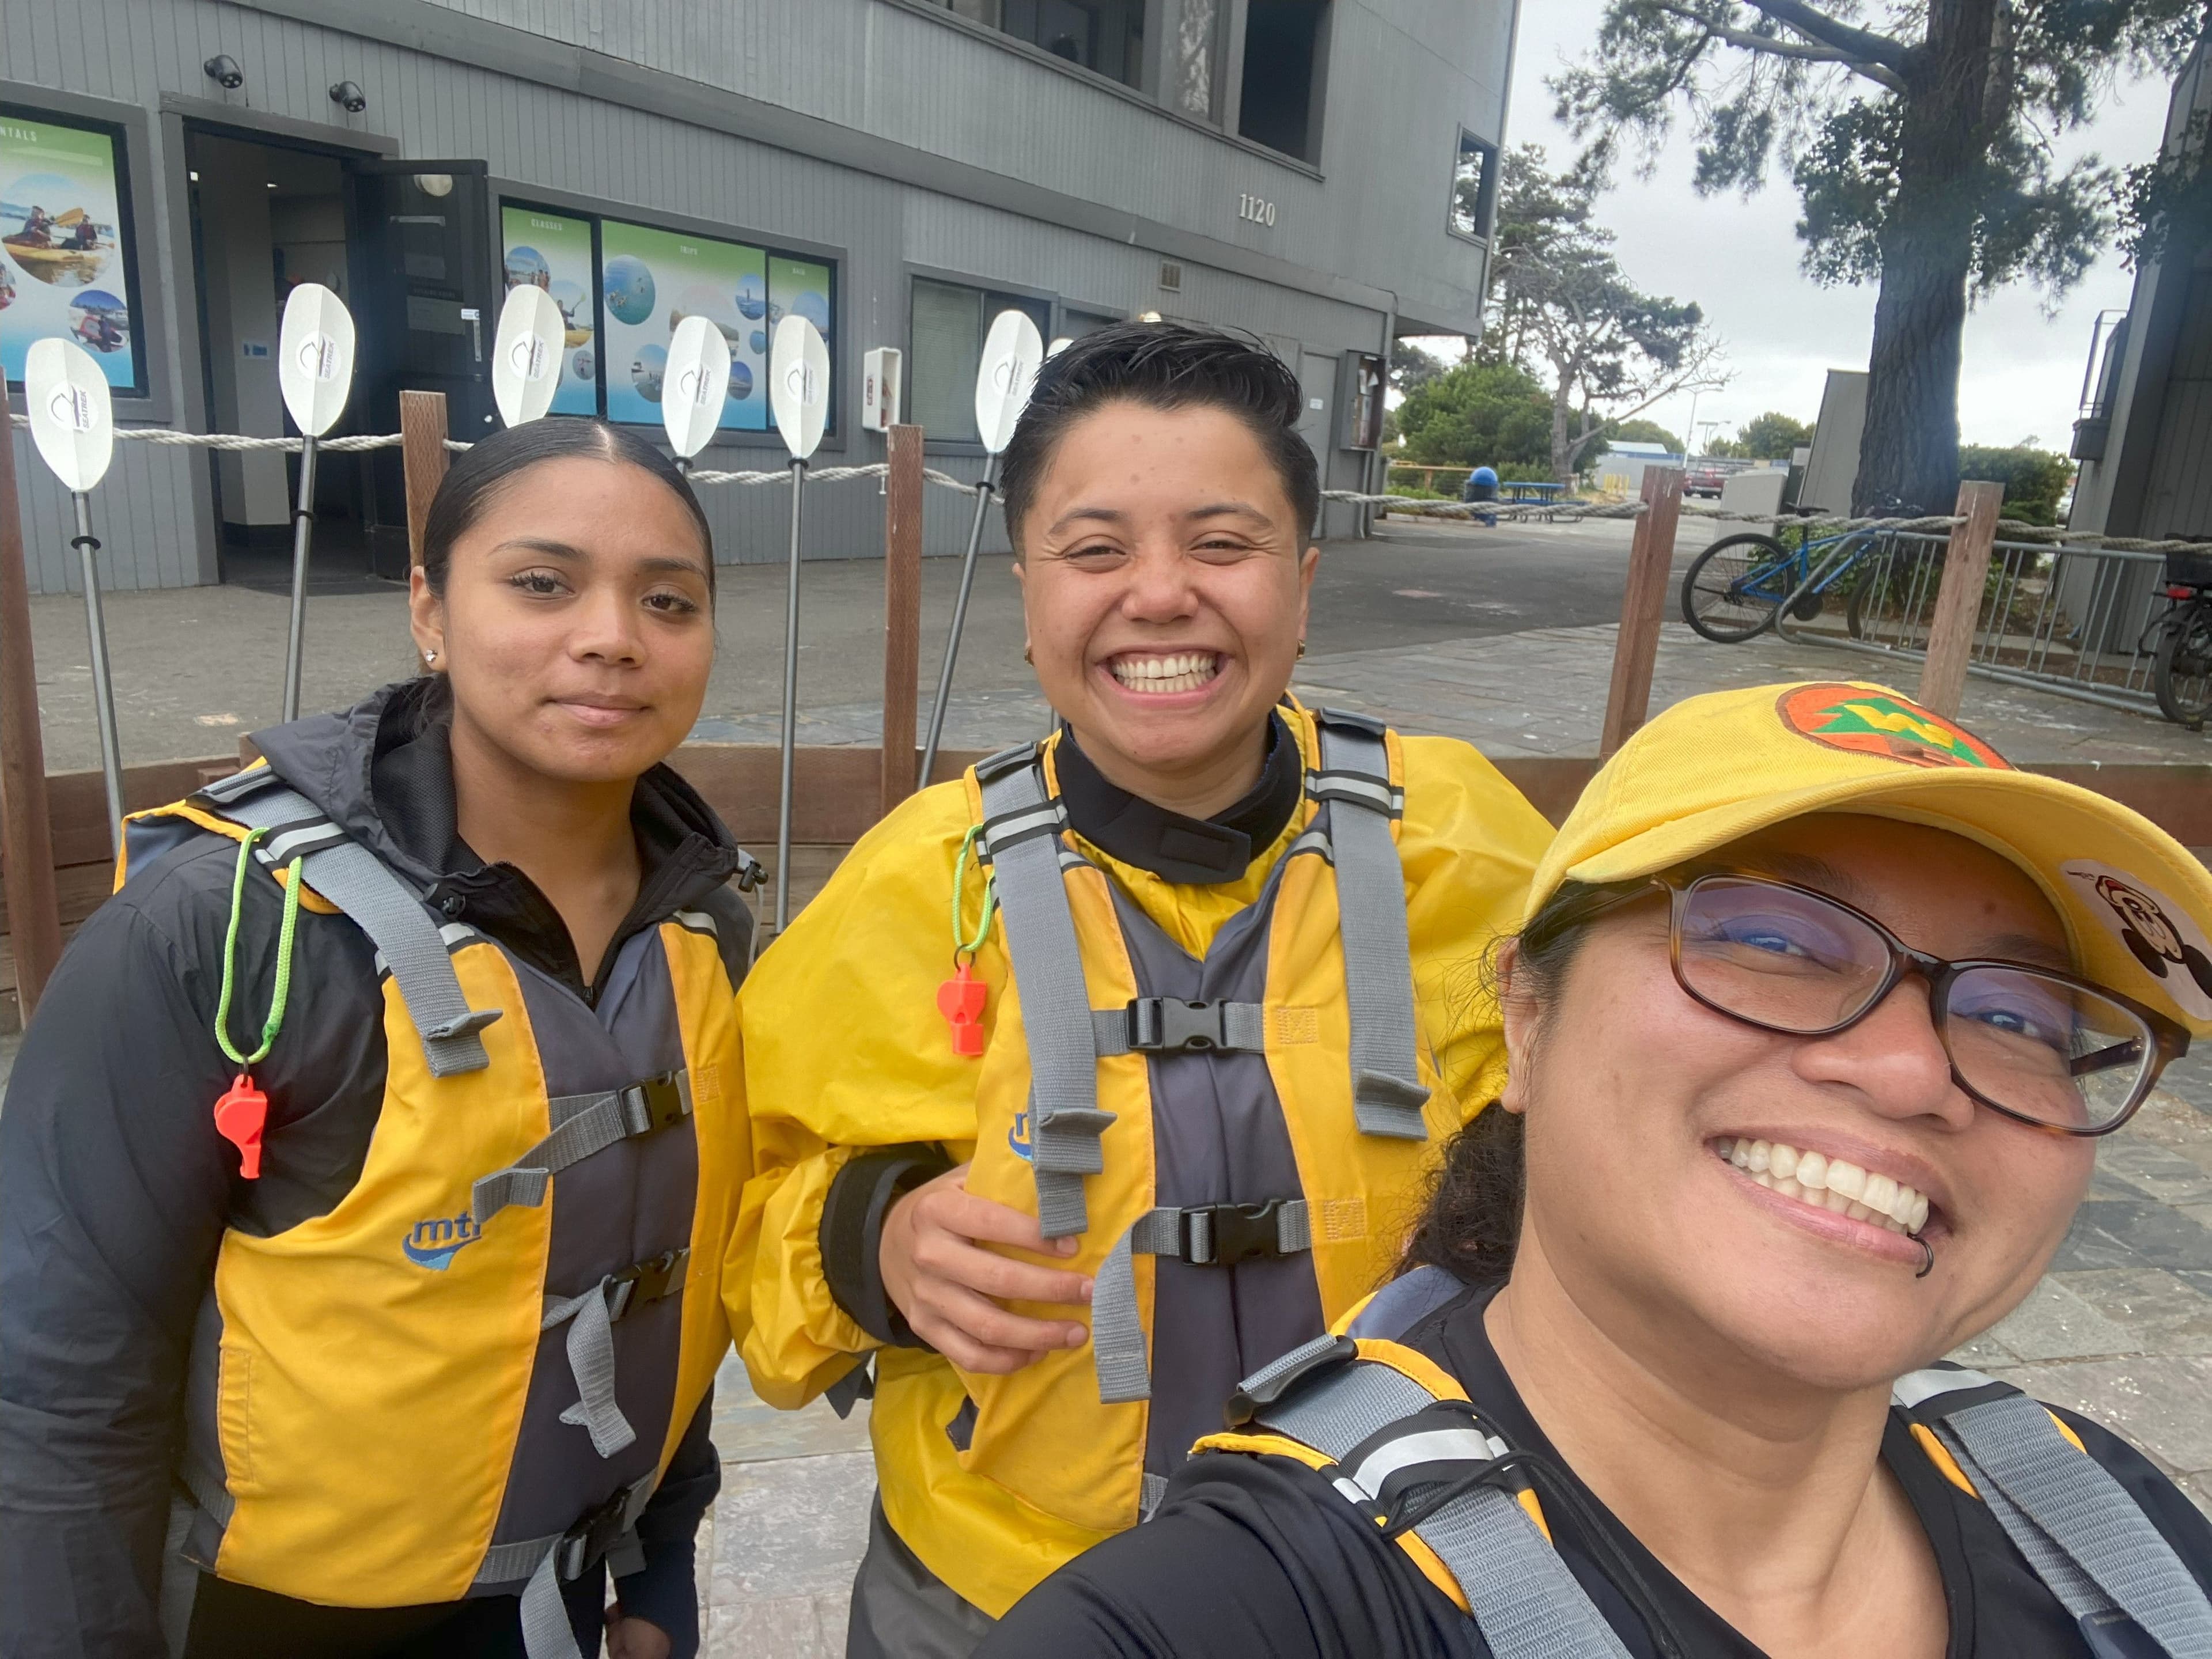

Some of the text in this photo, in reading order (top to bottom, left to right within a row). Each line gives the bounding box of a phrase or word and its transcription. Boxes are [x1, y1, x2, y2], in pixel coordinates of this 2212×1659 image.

[1239, 194, 1275, 226] 1120
[324, 341, 335, 379] SEATREK
[533, 340, 544, 378] SEATREK
[79, 390, 89, 429] SEATREK
